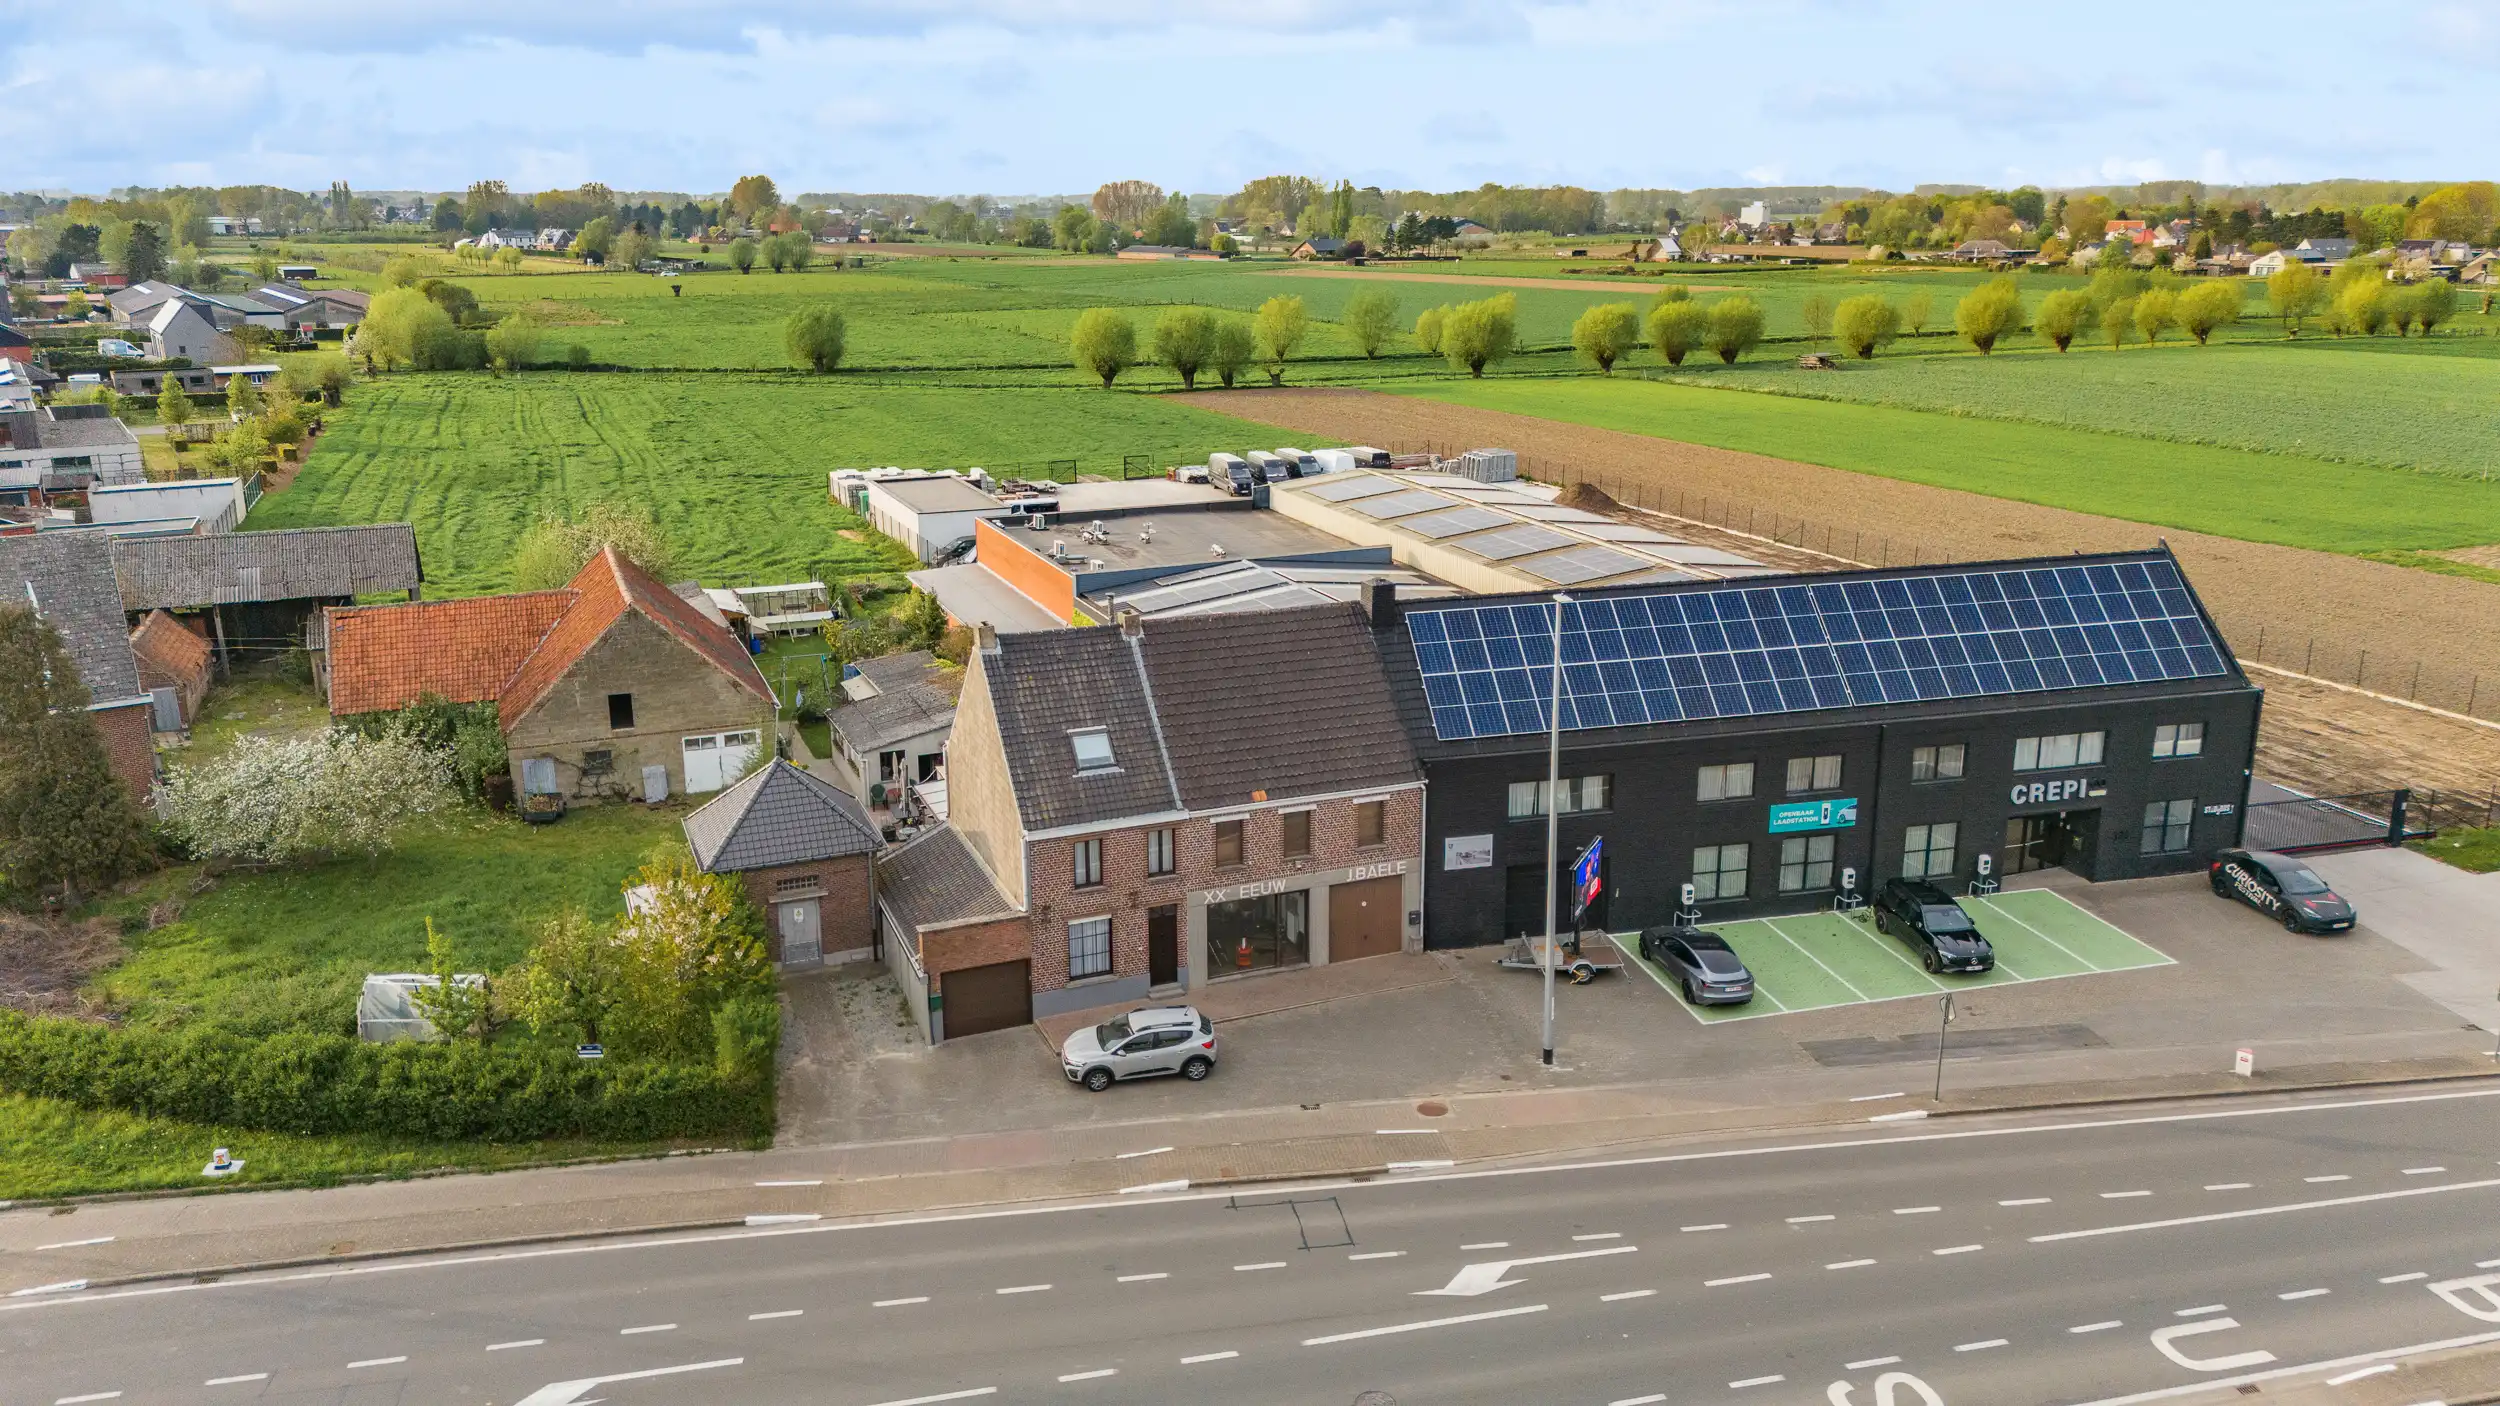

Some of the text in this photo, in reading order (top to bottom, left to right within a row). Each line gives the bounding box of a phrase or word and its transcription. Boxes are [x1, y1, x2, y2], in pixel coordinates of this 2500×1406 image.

[2010, 778, 2087, 805] CREPI
[1773, 816, 1819, 825] LAADSTATION
[1779, 809, 1815, 818] OPENBAAR
[1239, 879, 1286, 899] EEUW
[2225, 863, 2281, 911] CURIOSITY
